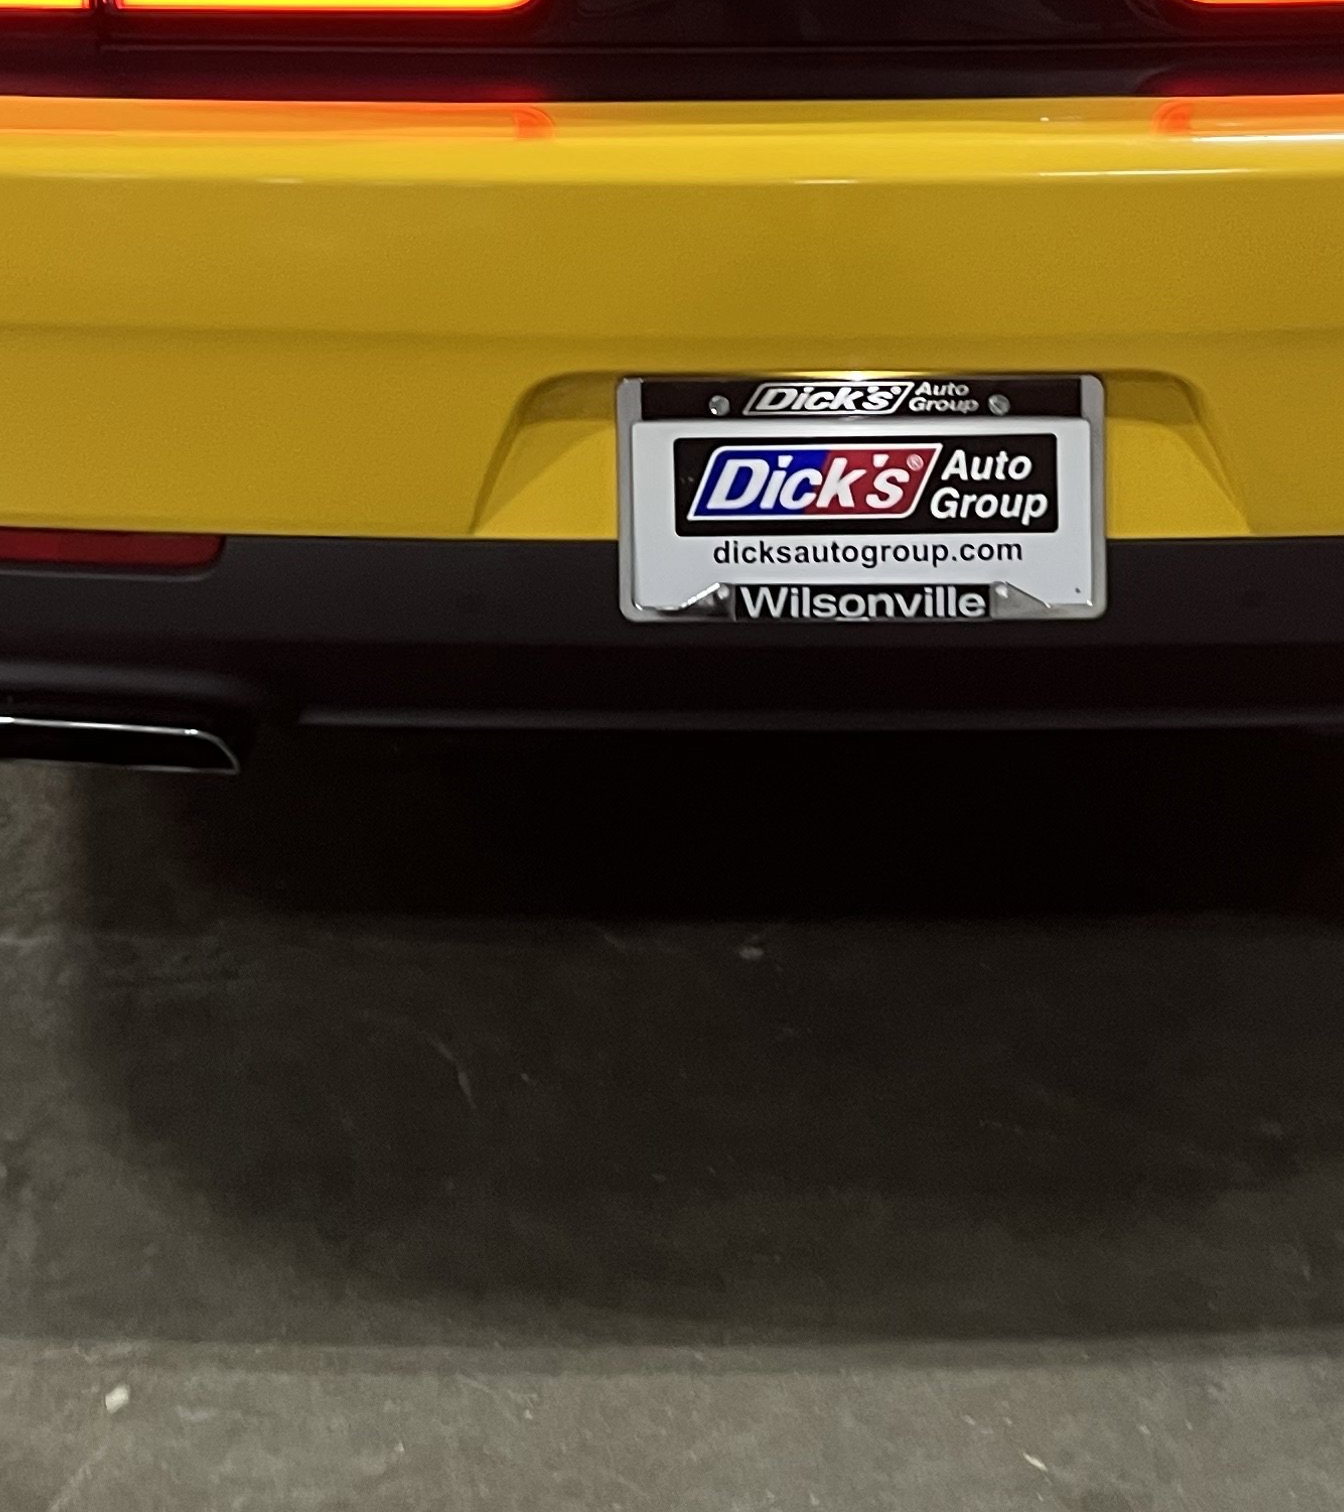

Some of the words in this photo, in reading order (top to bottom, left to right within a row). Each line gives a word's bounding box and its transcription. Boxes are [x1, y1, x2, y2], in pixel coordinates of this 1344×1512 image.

[756, 386, 894, 411] Dick's
[915, 381, 970, 397] Auto
[908, 397, 979, 414] Group
[941, 450, 1033, 482] Auto
[706, 454, 909, 511] Dick's
[930, 488, 1048, 525] Group
[713, 540, 1023, 568] dicksautogroup.com
[739, 586, 987, 620] Wilsonville
